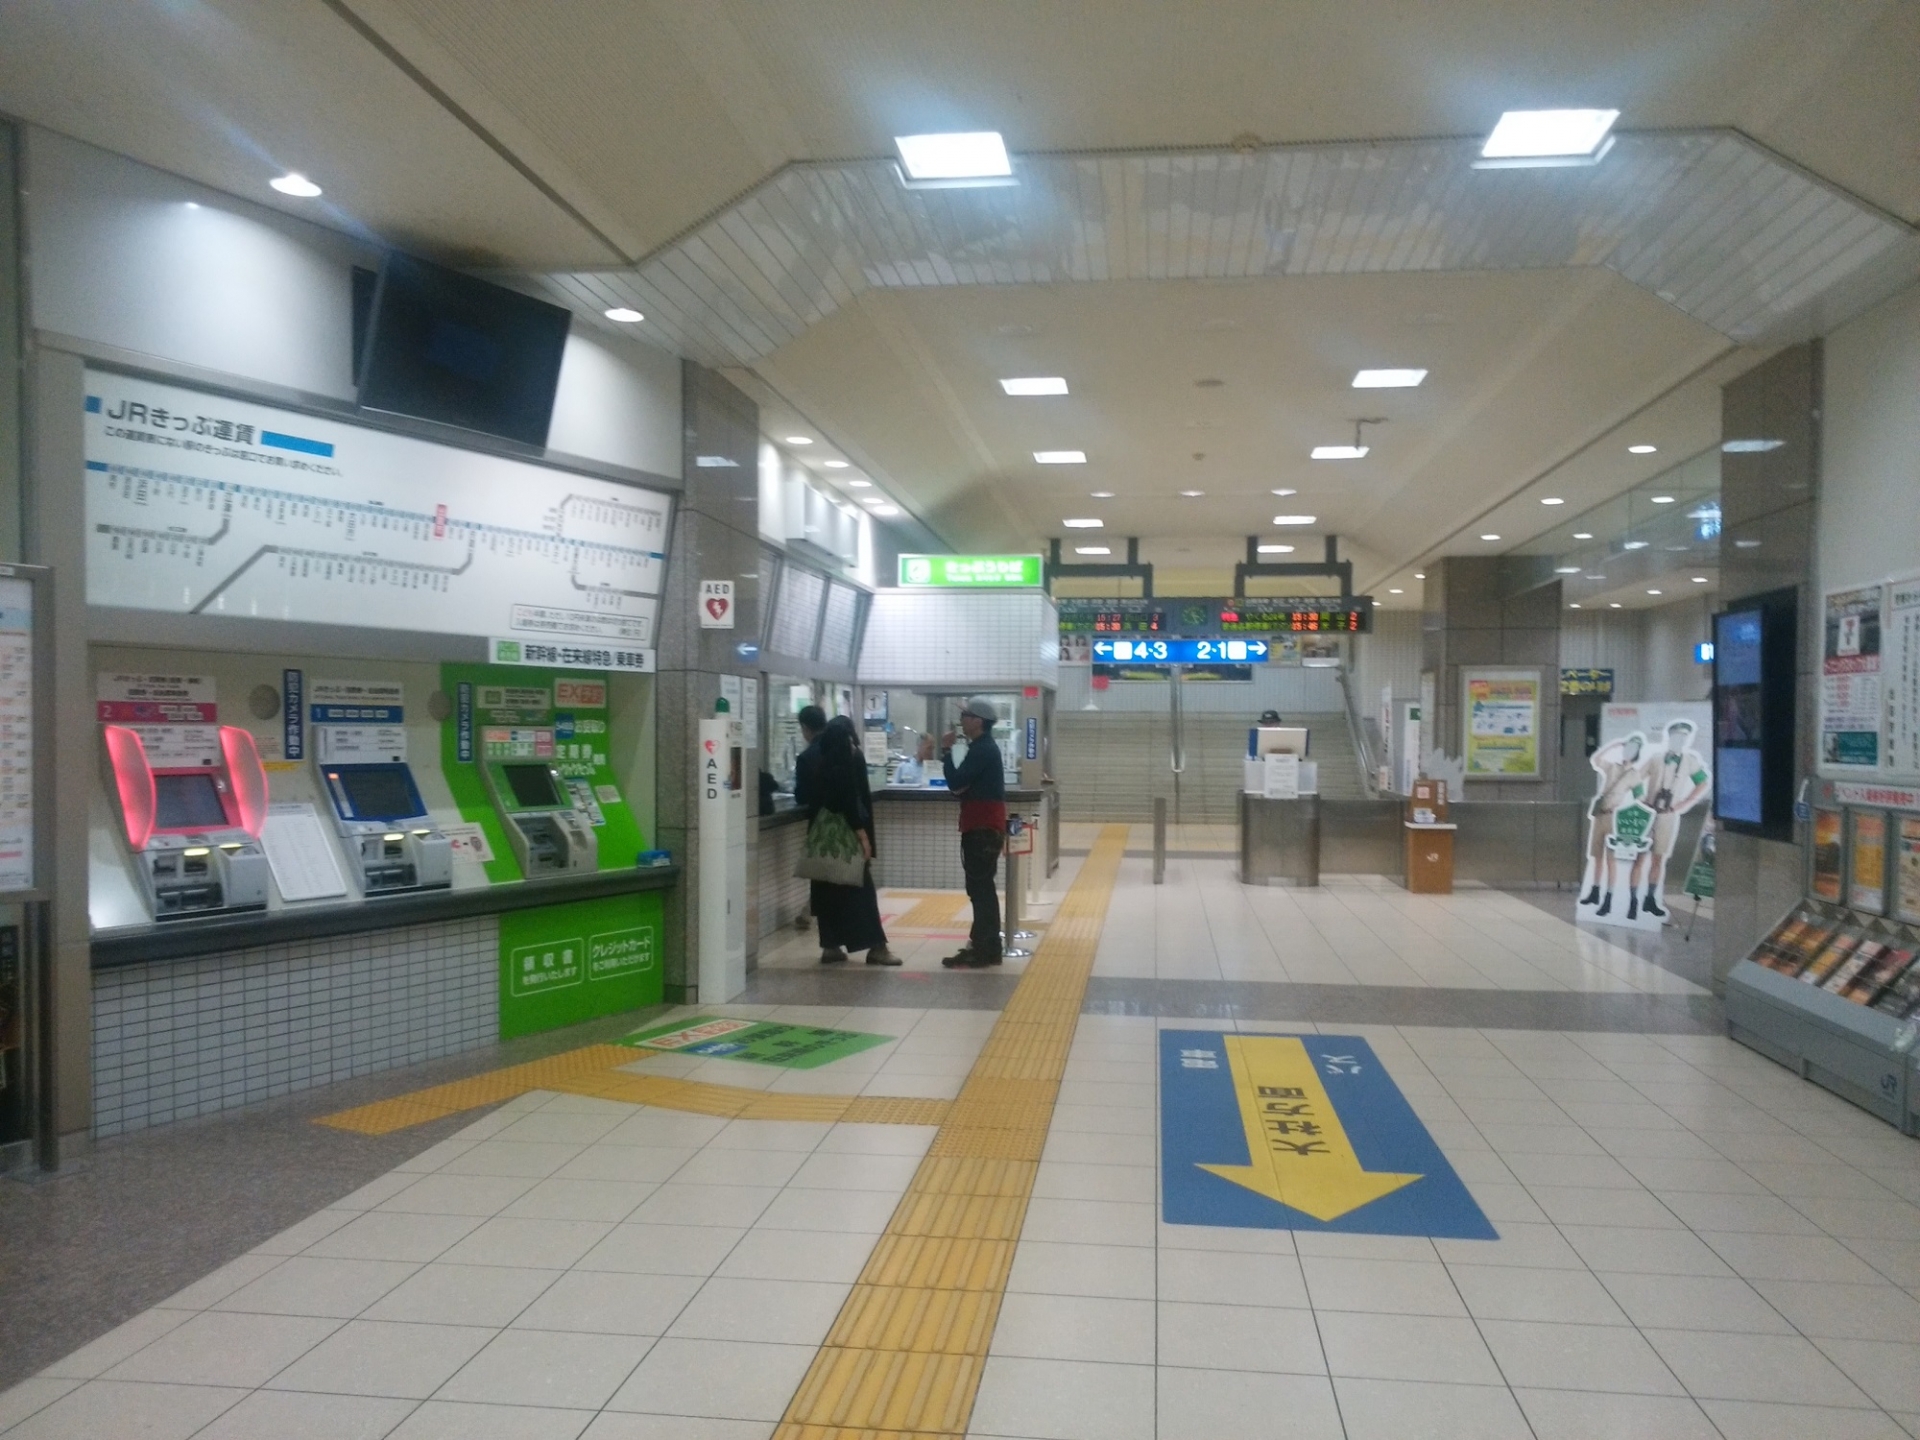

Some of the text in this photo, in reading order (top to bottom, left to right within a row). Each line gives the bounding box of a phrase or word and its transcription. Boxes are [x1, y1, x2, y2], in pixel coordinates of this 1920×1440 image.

[107, 400, 256, 446] JRきっぷ運賃
[705, 583, 730, 595] AED
[706, 758, 718, 799] AED
[593, 936, 651, 959] クレジットカード
[1321, 1054, 1363, 1075] バス
[1257, 1086, 1331, 1156] 大社方面
